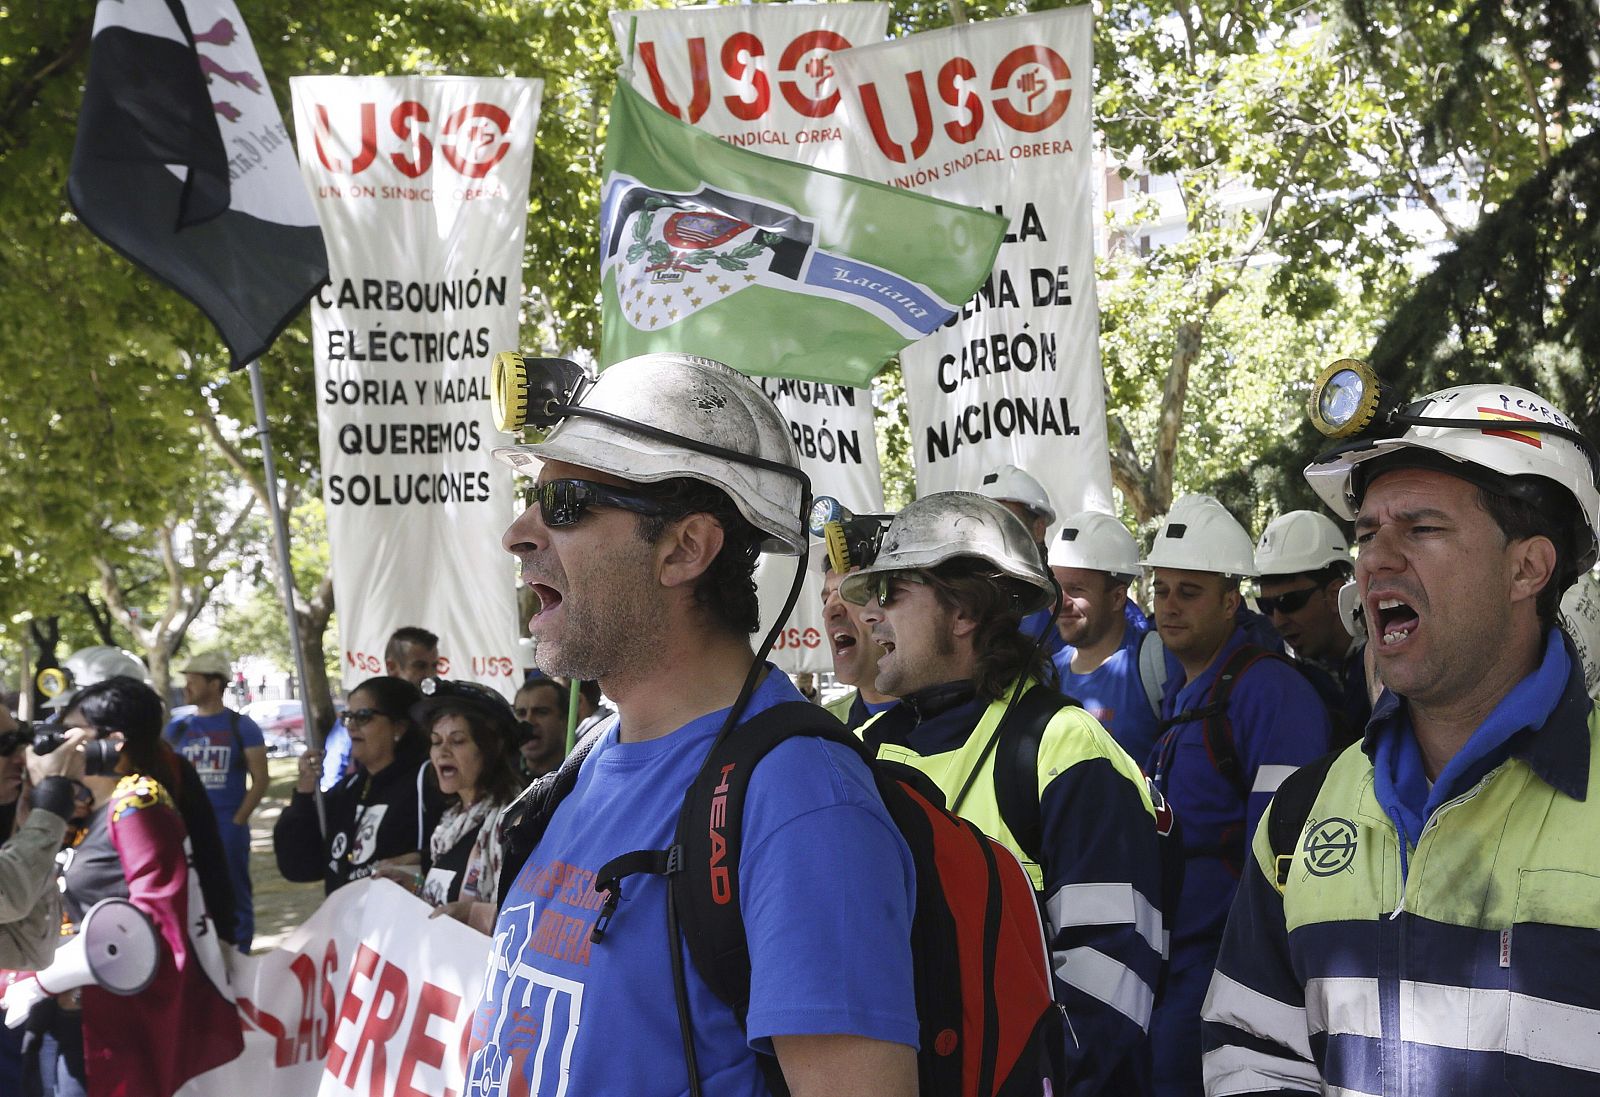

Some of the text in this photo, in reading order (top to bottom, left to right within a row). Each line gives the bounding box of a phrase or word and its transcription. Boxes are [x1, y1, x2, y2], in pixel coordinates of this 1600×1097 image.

[637, 30, 853, 125] USO
[857, 45, 1073, 165] USO
[314, 100, 511, 179] USO
[943, 148, 1005, 177] SINDICAL
[1009, 139, 1073, 159] OBRERA
[381, 186, 435, 201] SINDIC
[317, 269, 507, 313] CARBOUNIÓN
[832, 266, 929, 320] Laciana
[1030, 265, 1072, 307] DE
[328, 322, 490, 363] ELÉCTRICAS
[938, 322, 1057, 394] CARBÓN
[325, 376, 491, 406] SORIA Y NADAL
[926, 397, 1080, 463] NACIONAL
[1516, 399, 1580, 431] CARB
[338, 420, 480, 456] QUEREMOS
[791, 418, 862, 464] RBÓN
[329, 471, 491, 506] SOLUCIONES
[471, 656, 514, 677] USO
[709, 762, 736, 905] HEAD
